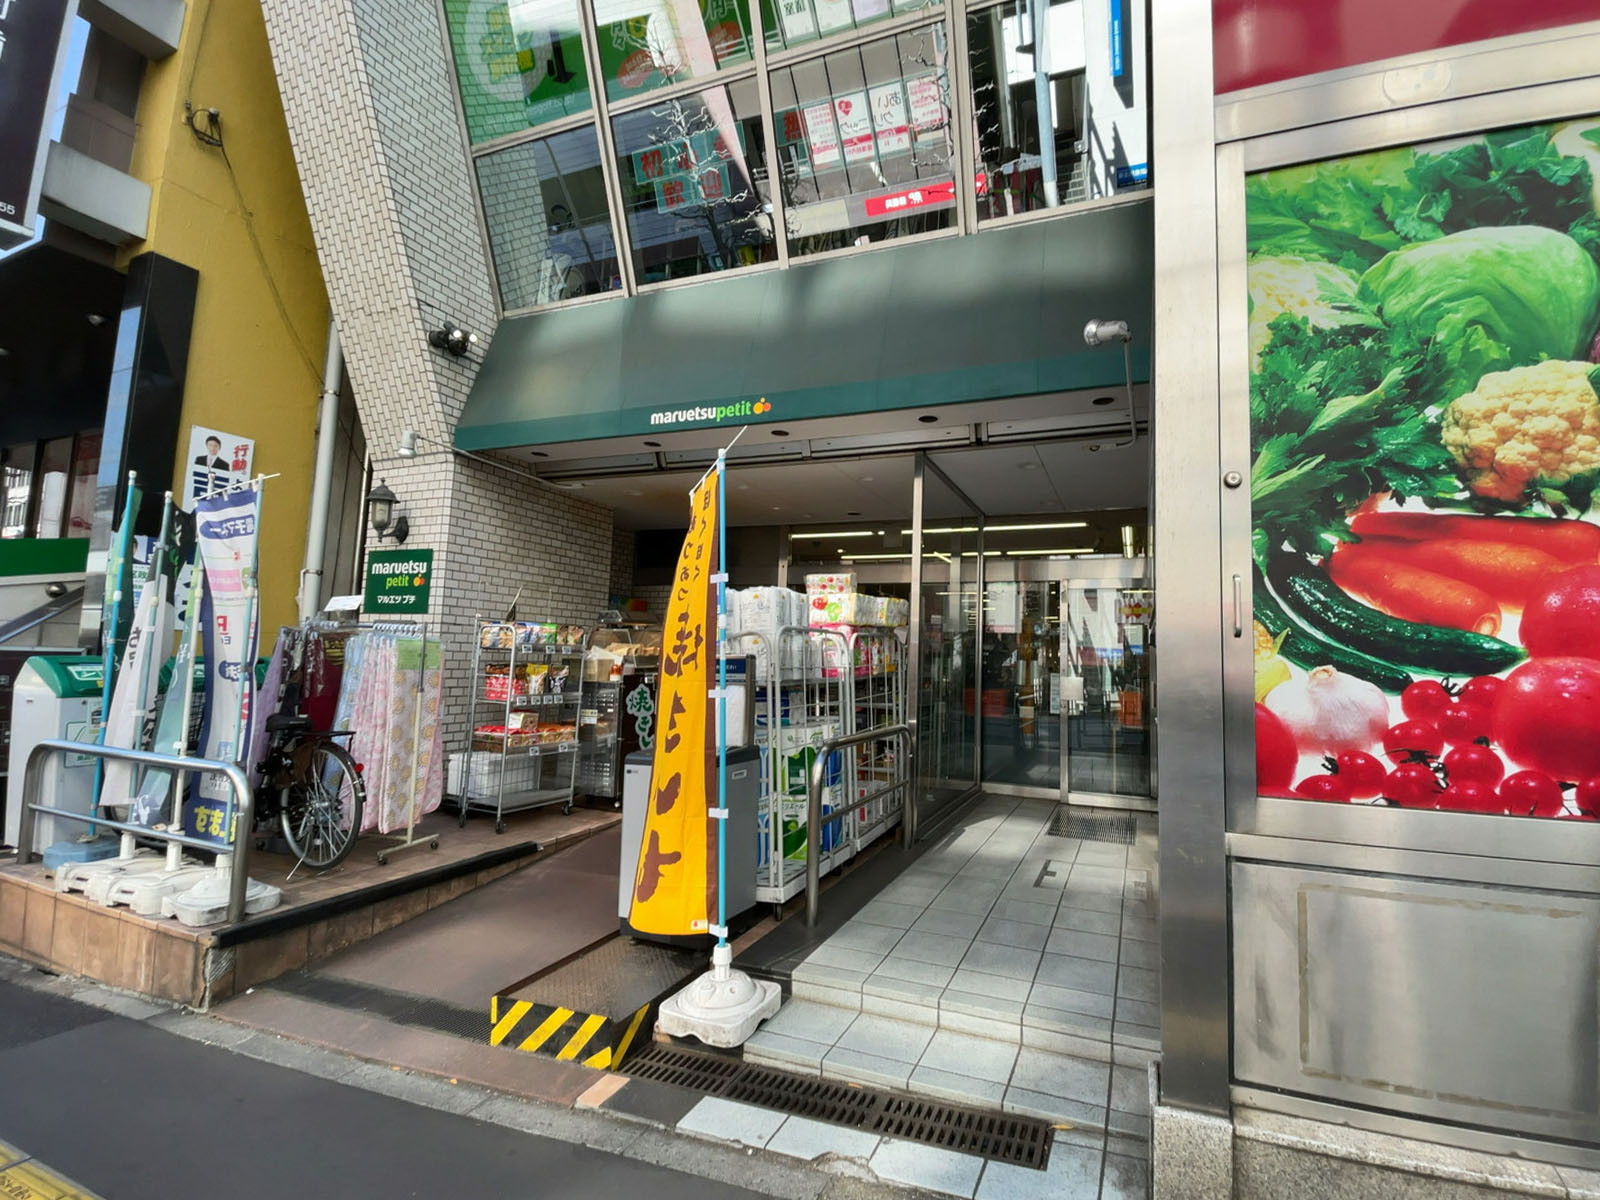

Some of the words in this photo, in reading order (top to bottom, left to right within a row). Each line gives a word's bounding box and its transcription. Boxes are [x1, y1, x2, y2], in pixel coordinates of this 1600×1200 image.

[371, 560, 427, 575] maruetsu
[385, 574, 409, 590] petit
[377, 595, 402, 605] マルエツ
[402, 594, 416, 604] プチ
